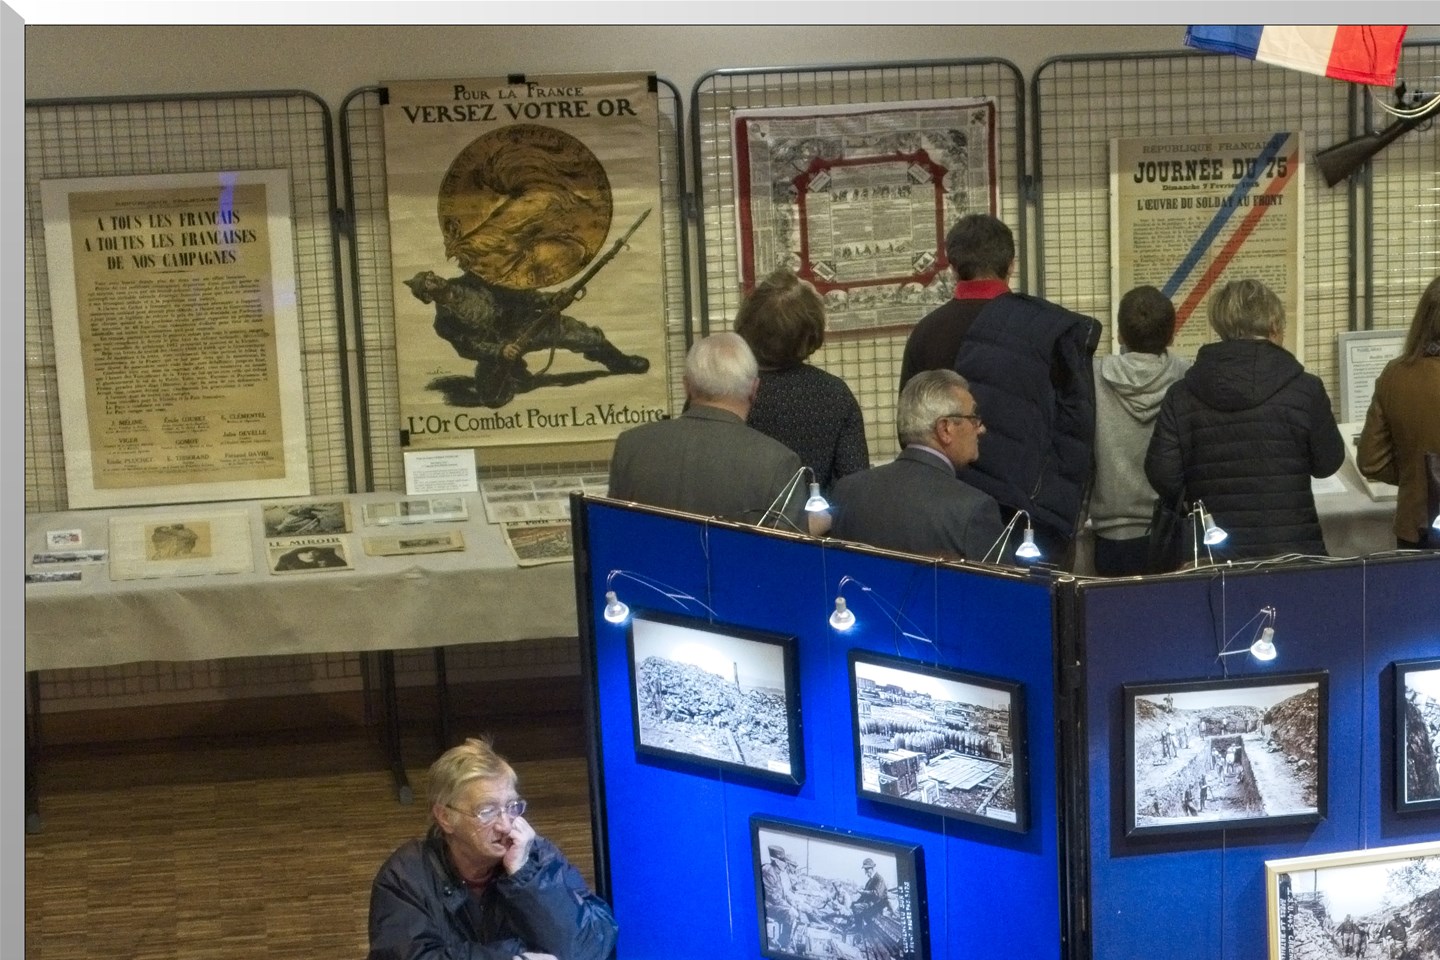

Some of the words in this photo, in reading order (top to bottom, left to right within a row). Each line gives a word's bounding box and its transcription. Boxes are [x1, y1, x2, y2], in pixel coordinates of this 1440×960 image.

[402, 103, 498, 124] VERSEZ
[503, 100, 590, 120] VOTRE
[597, 98, 637, 117] OR
[1134, 158, 1223, 183] JOURNÉE
[1232, 158, 1258, 179] DU
[1266, 156, 1288, 179] 75
[1180, 197, 1193, 209] DU
[1196, 195, 1233, 208] SOLDAT
[1237, 195, 1250, 206] AU
[1253, 194, 1284, 206] FRONT
[110, 214, 143, 231] TOUS
[149, 213, 173, 228] LES
[96, 234, 145, 251] TOUTES
[151, 233, 175, 249] LES
[107, 256, 124, 270] DE
[132, 254, 156, 269] NOS
[162, 250, 237, 268] CAMPAGNES
[408, 414, 451, 435] L'Or
[454, 410, 522, 431] Combat
[526, 408, 569, 428] Pour
[571, 406, 598, 426] La
[595, 403, 664, 425] Victoire
